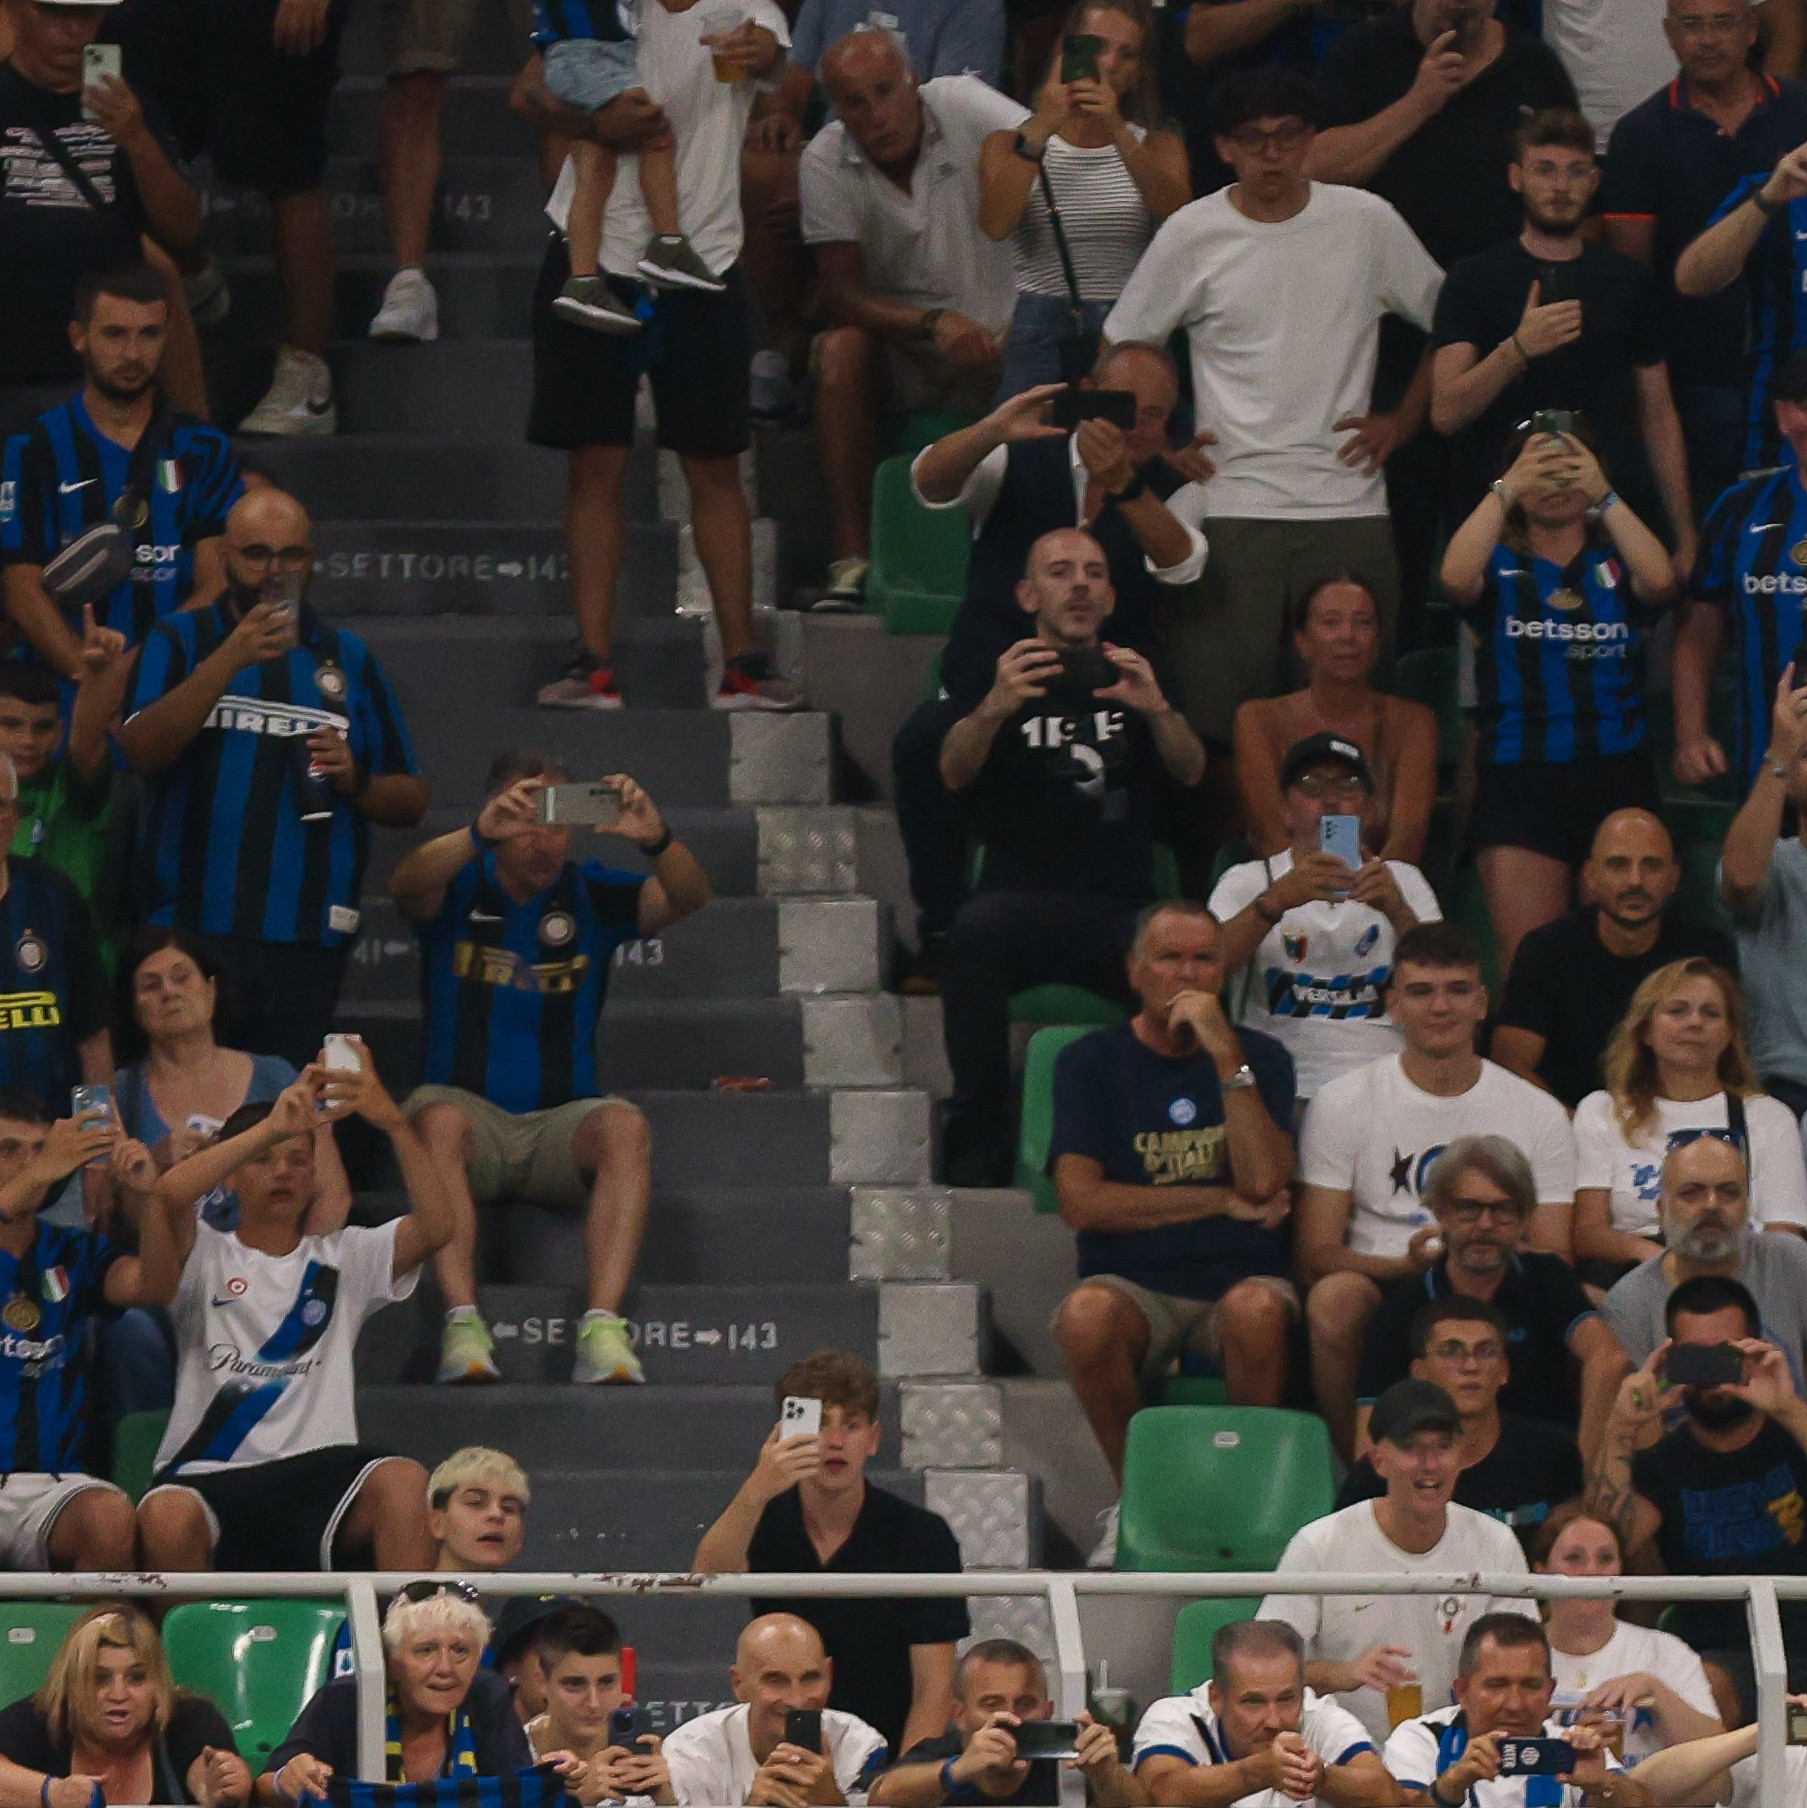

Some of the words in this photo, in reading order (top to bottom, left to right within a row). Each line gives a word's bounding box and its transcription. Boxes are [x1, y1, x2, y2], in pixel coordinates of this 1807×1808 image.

[329, 553, 495, 584] SETTORE
[1504, 616, 1628, 641] betsson
[728, 1320, 779, 1350] 143
